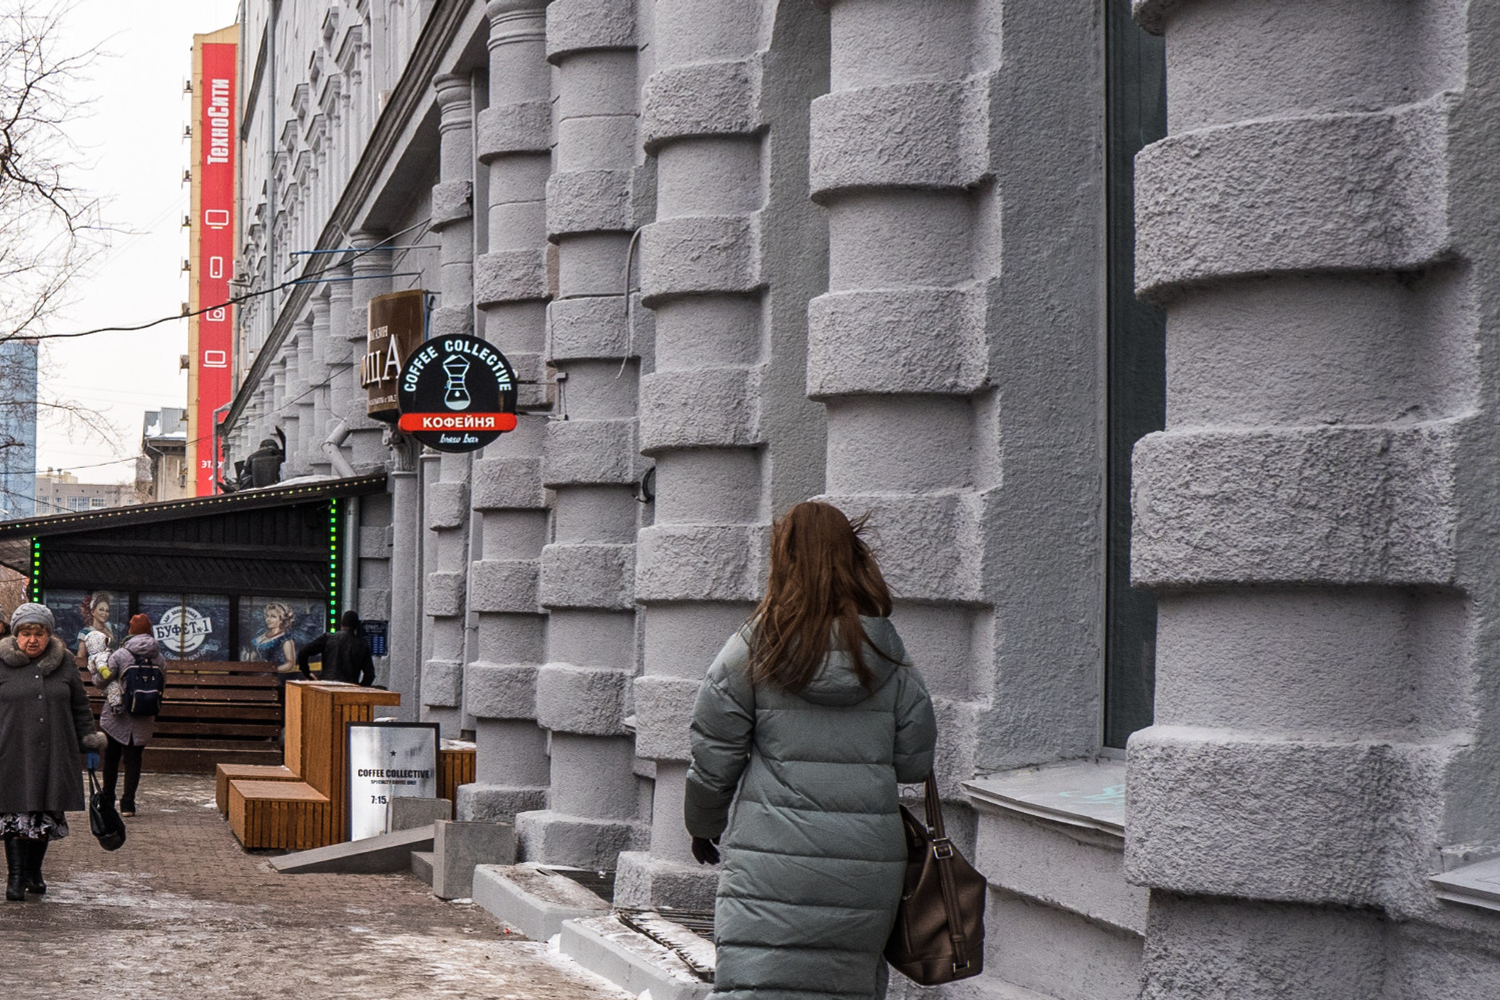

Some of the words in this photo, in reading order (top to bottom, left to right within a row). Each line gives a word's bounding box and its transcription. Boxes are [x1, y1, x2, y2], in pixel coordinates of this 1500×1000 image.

[207, 79, 229, 165] ТехноСити
[404, 346, 438, 392] COFFEE
[444, 340, 511, 391] COLLECTIVE
[422, 415, 495, 428] КОФЕЙНЯ
[155, 621, 197, 639] БУФЕТ
[357, 769, 385, 778] COFFEE
[386, 769, 430, 779] COLLECTIVE
